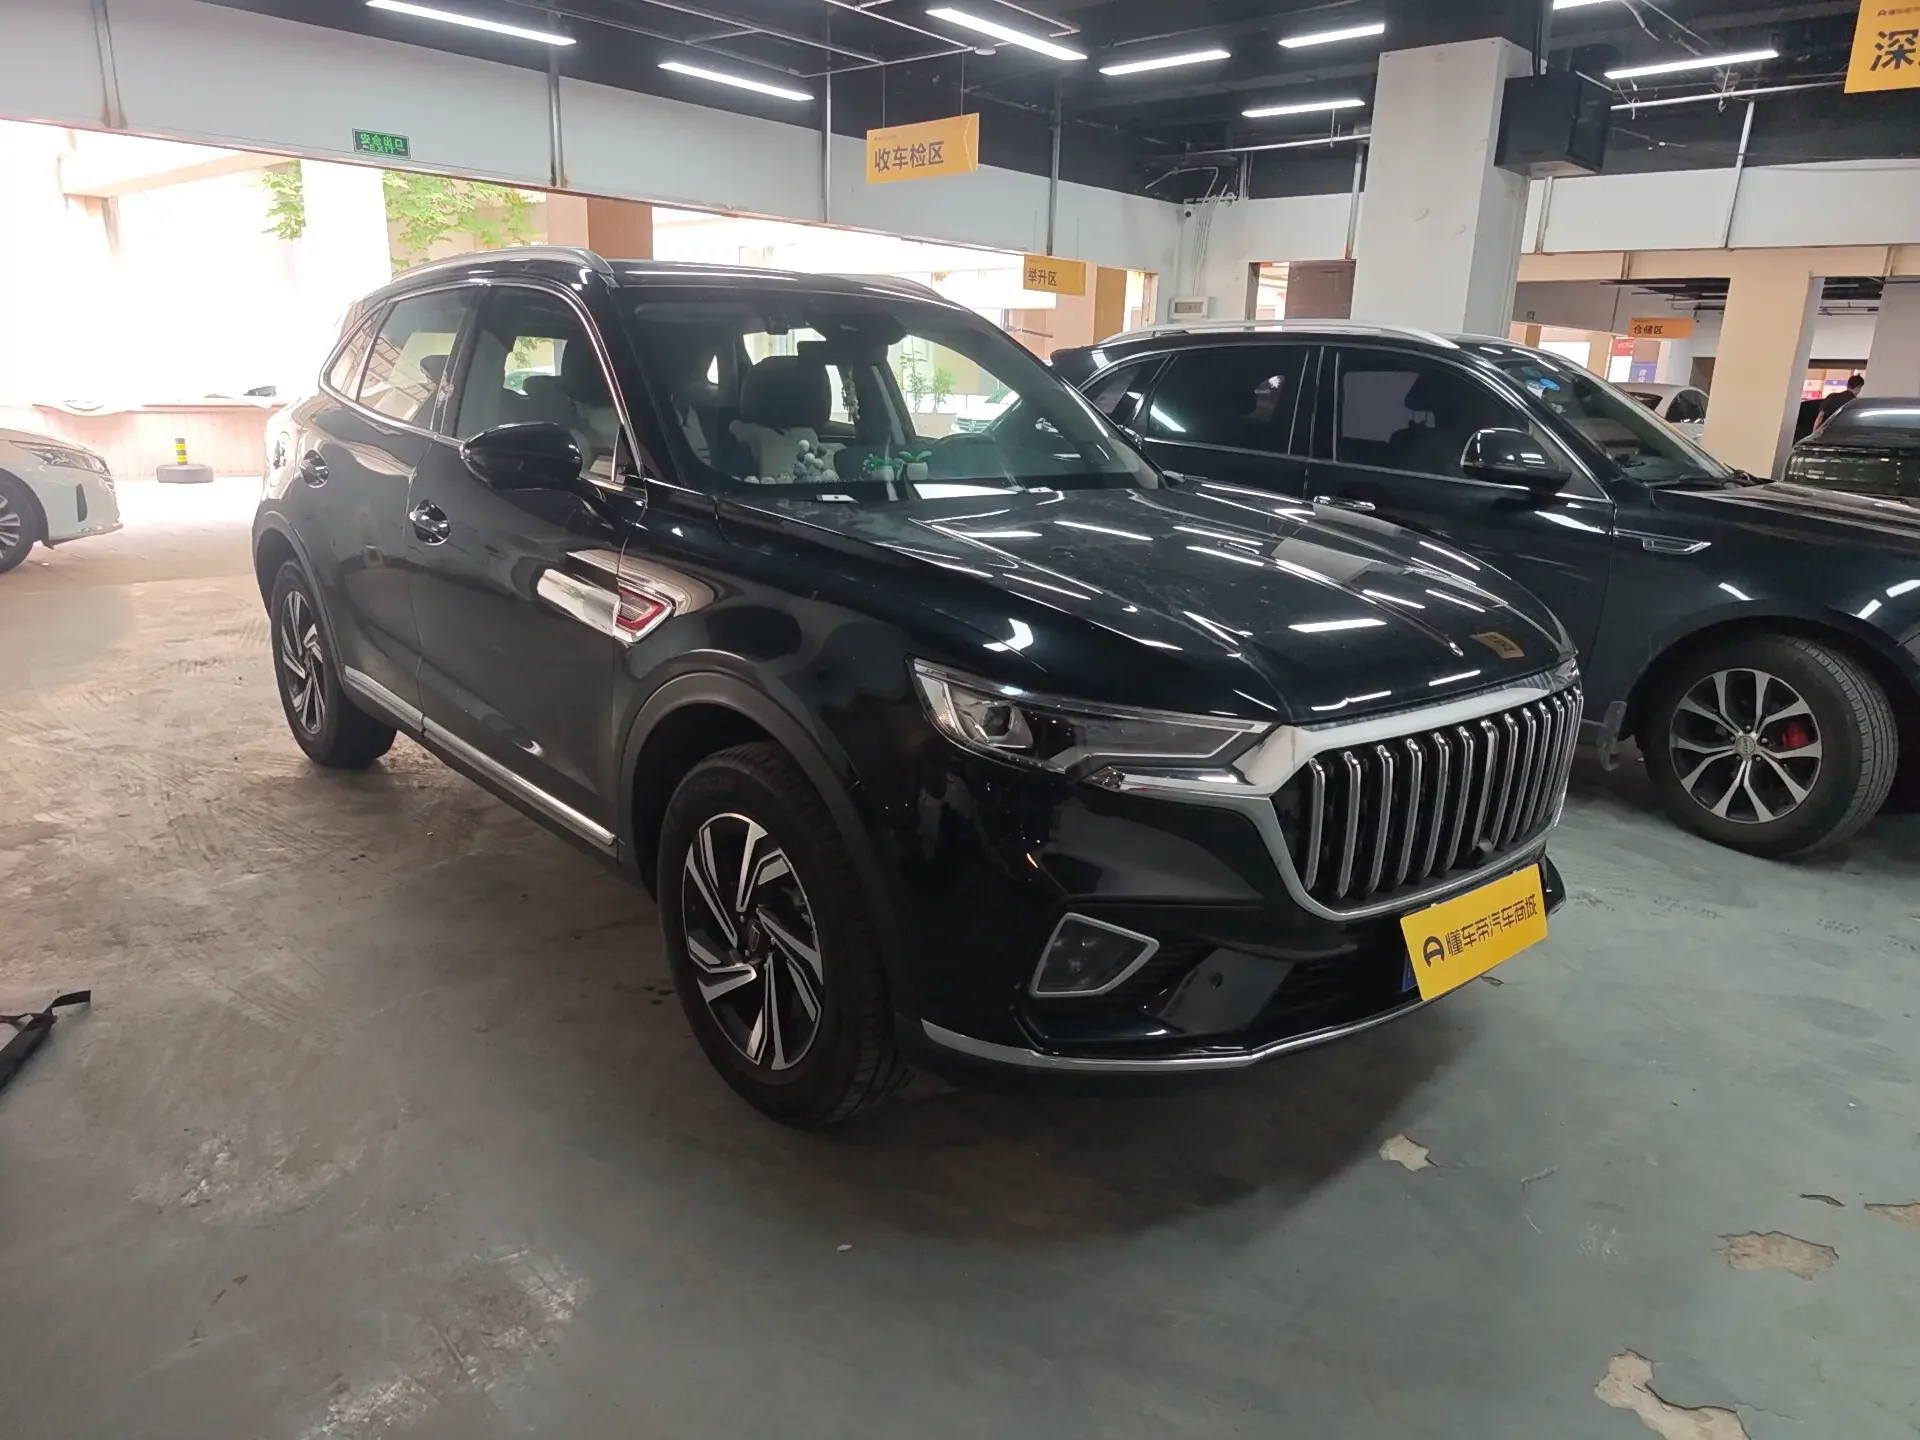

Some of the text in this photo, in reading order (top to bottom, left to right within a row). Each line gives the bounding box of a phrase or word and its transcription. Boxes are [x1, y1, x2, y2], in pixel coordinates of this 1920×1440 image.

[369, 144, 396, 154] EXIT
[874, 140, 945, 173] 收车检区
[1027, 267, 1058, 287] 举升区
[1633, 324, 1664, 335] 仓储区
[1445, 893, 1538, 956] 懂车帝汽车商城
